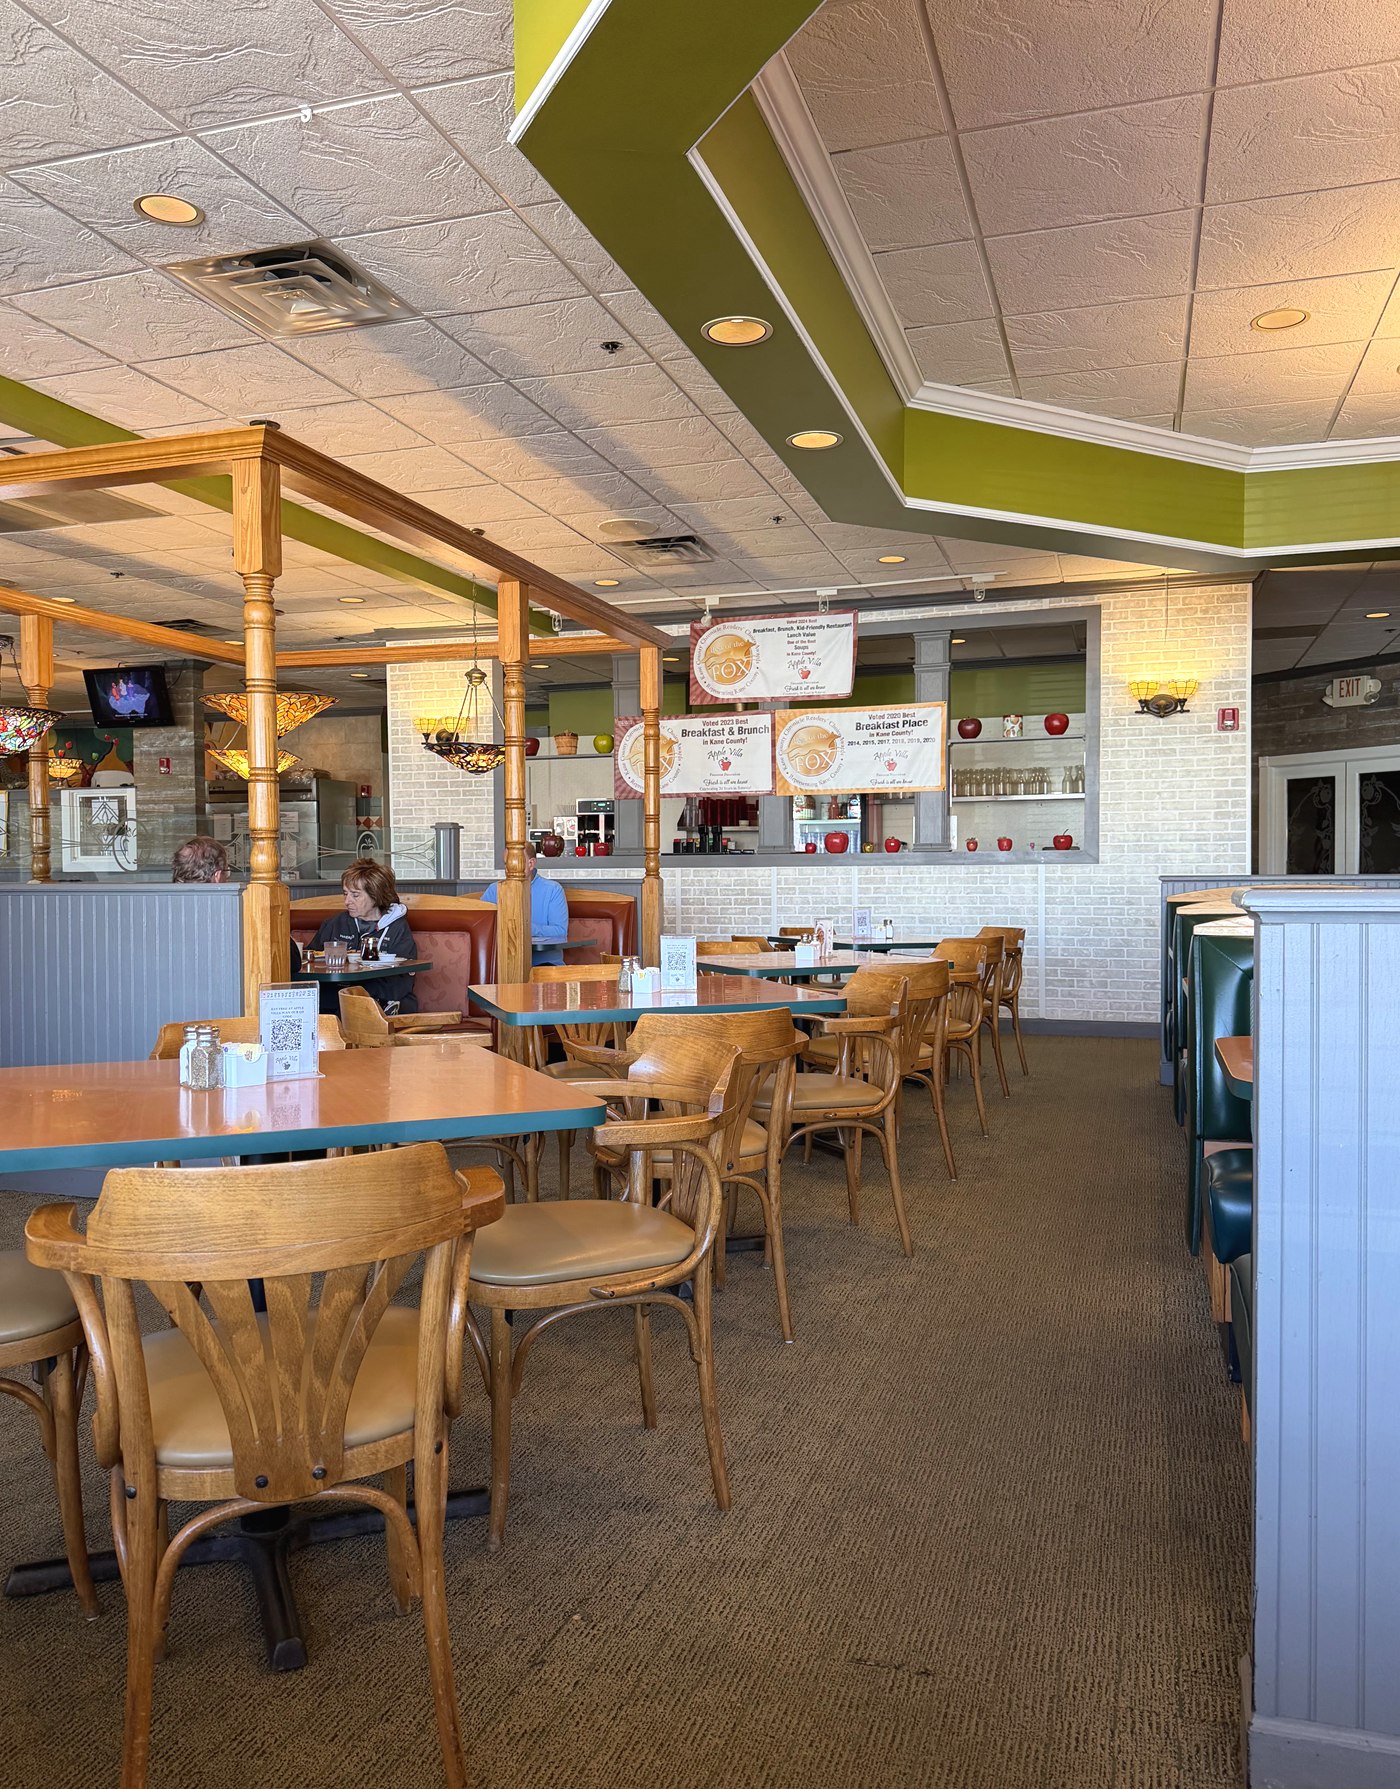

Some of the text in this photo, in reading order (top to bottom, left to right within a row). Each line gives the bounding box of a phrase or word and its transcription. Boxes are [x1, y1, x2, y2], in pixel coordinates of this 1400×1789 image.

[712, 660, 749, 681] FOX
[1339, 678, 1361, 698] EXIT
[681, 725, 770, 737] Breakfast & Brunch
[856, 719, 928, 731] Breakfast Place
[707, 747, 726, 760] Apple
[796, 750, 833, 772] FOX
